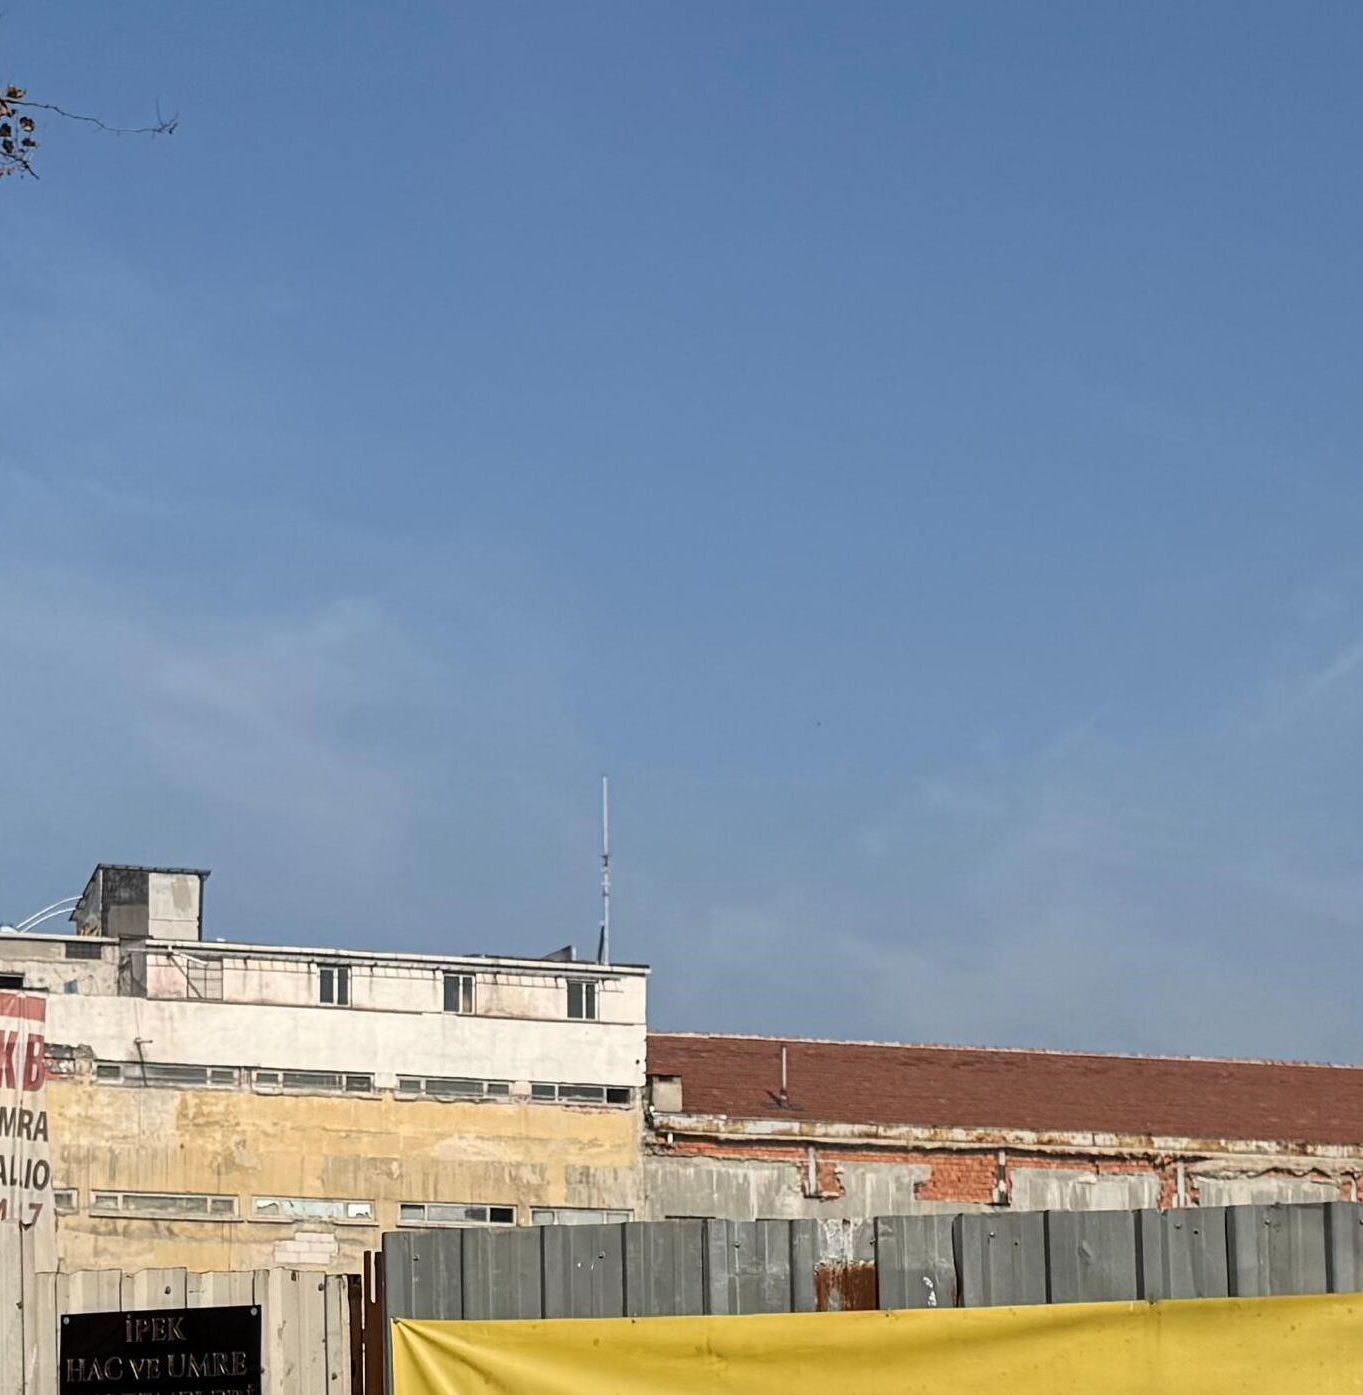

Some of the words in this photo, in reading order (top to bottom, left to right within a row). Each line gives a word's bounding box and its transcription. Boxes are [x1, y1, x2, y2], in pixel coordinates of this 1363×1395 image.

[125, 1314, 187, 1343] İPEK
[66, 1356, 124, 1383] HAC
[128, 1358, 162, 1380] VE
[167, 1351, 248, 1378] UMRE
